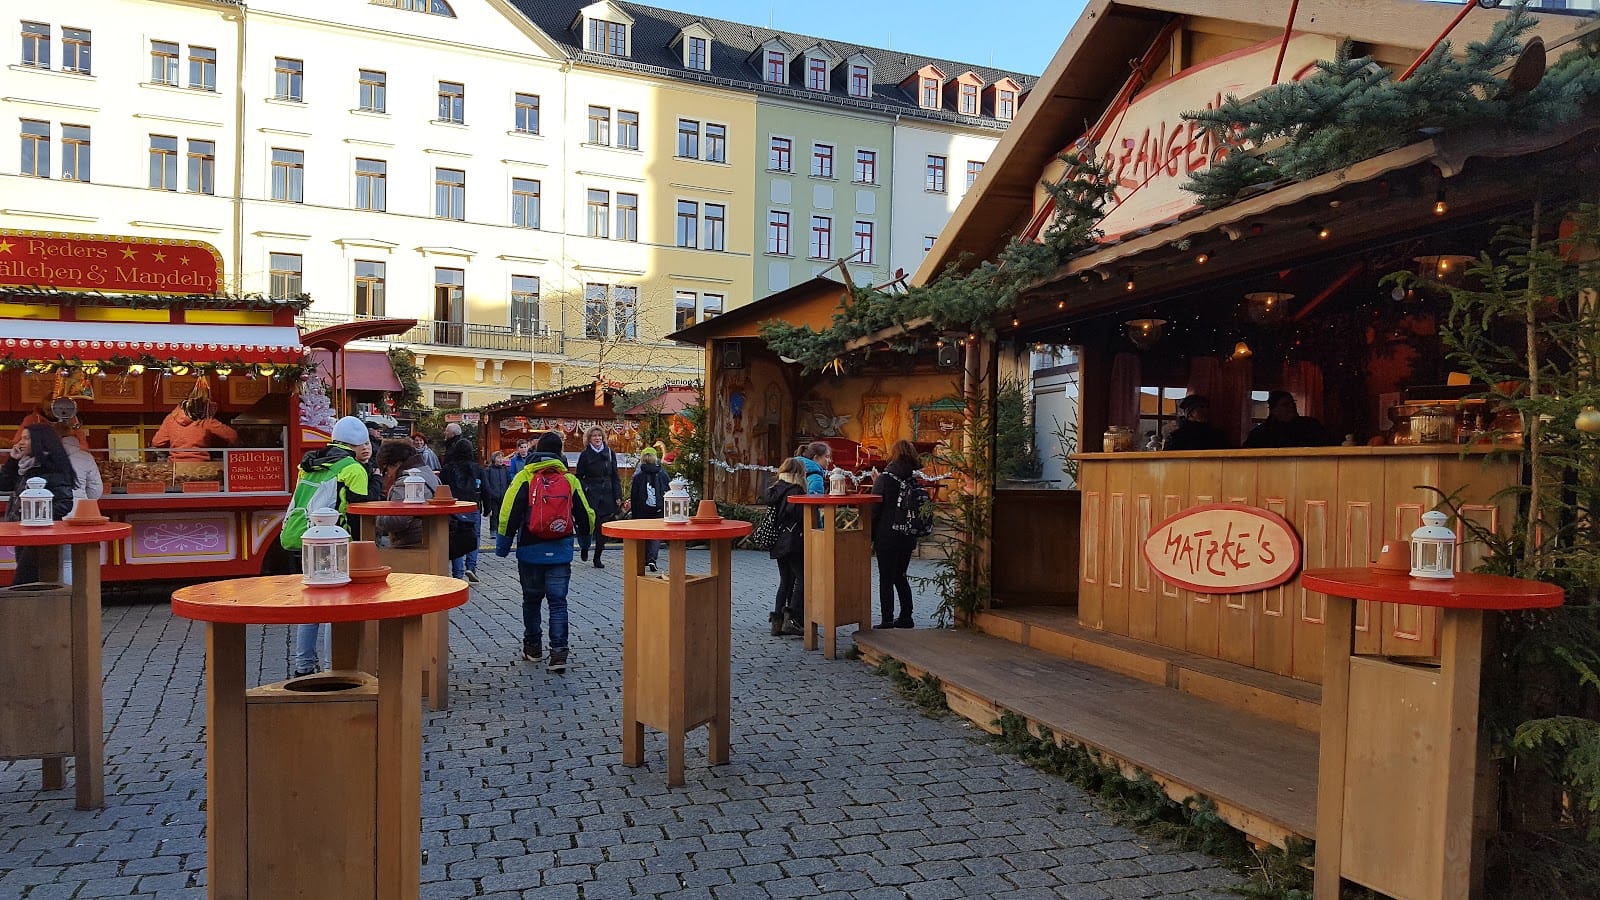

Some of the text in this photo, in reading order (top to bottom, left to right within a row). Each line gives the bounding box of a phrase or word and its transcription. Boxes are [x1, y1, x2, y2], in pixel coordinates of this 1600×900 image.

[28, 239, 108, 260] Reders
[0, 260, 213, 291] ällchen & Mandeln
[230, 452, 283, 464] Bällchen
